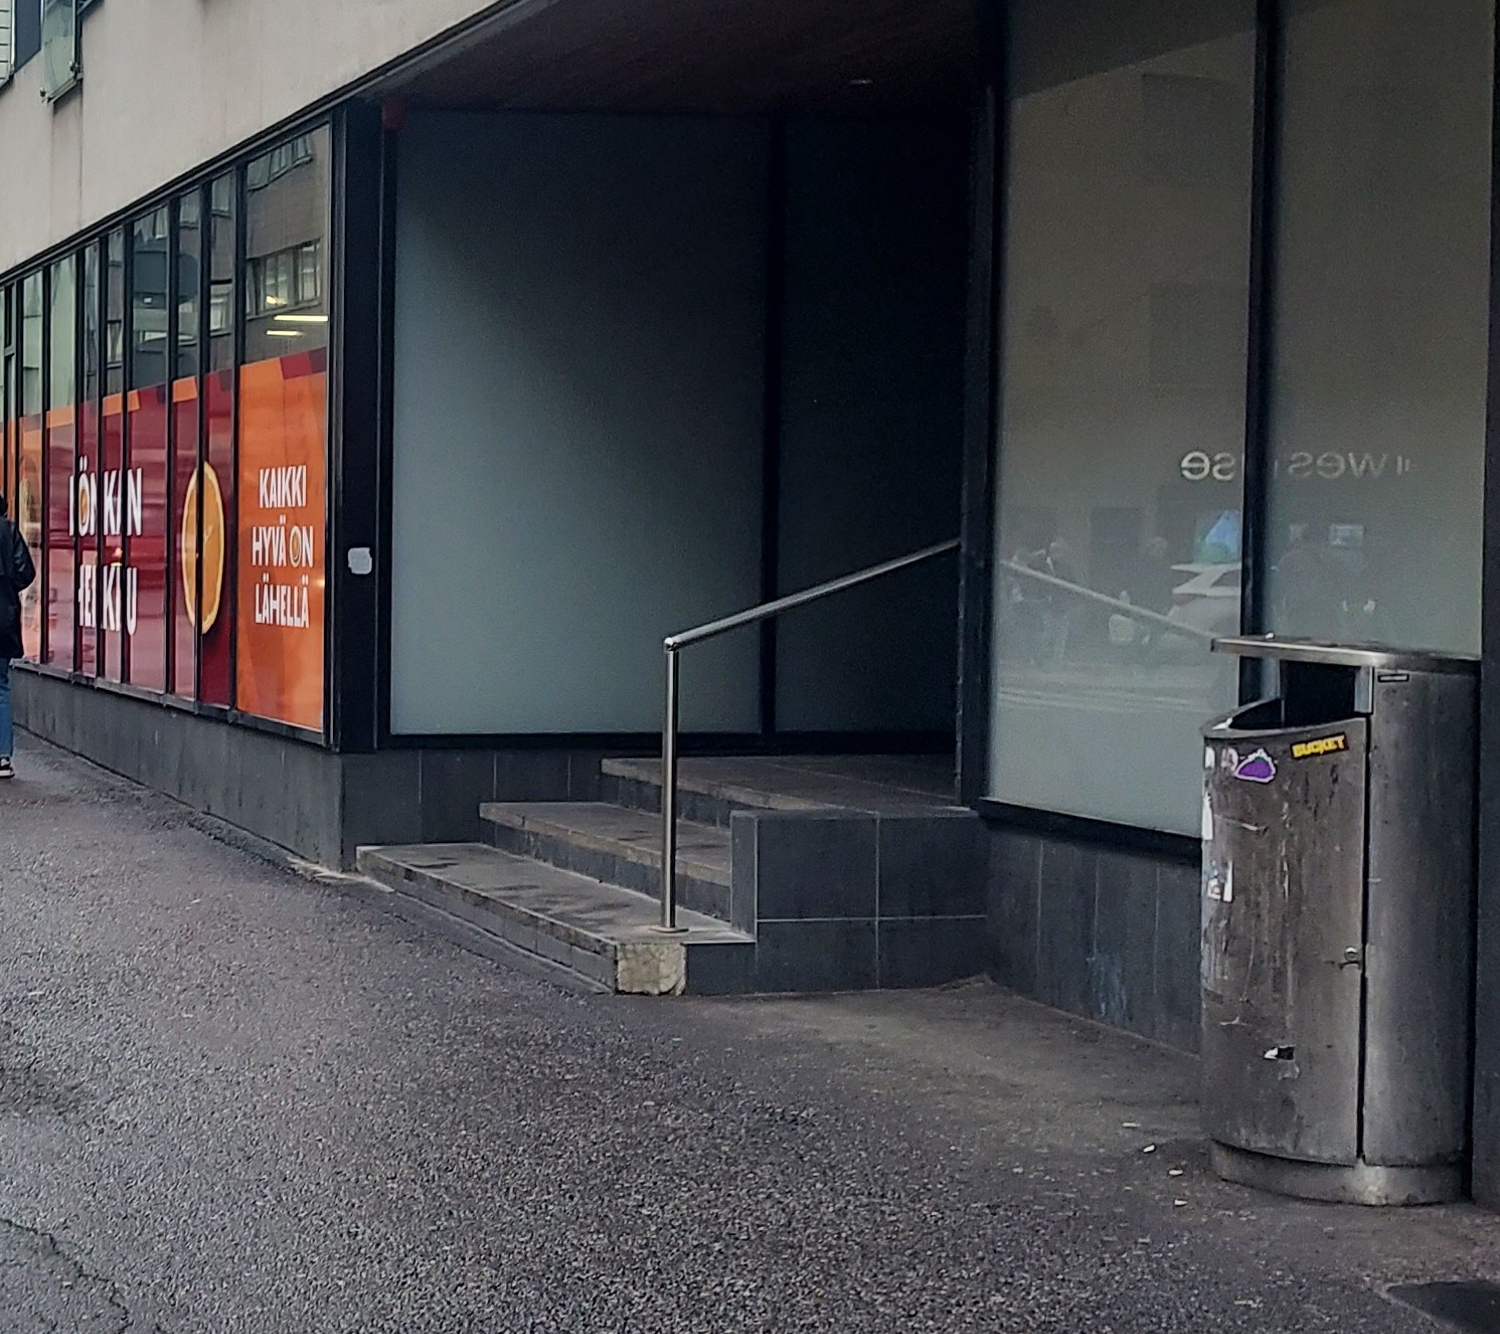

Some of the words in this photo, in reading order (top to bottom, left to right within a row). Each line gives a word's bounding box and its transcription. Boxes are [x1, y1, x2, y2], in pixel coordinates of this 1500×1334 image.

[259, 465, 307, 509] KAIKKI
[252, 514, 287, 566] HYVÄ
[289, 525, 314, 567] ON
[255, 573, 310, 628] LÄHELLÄ
